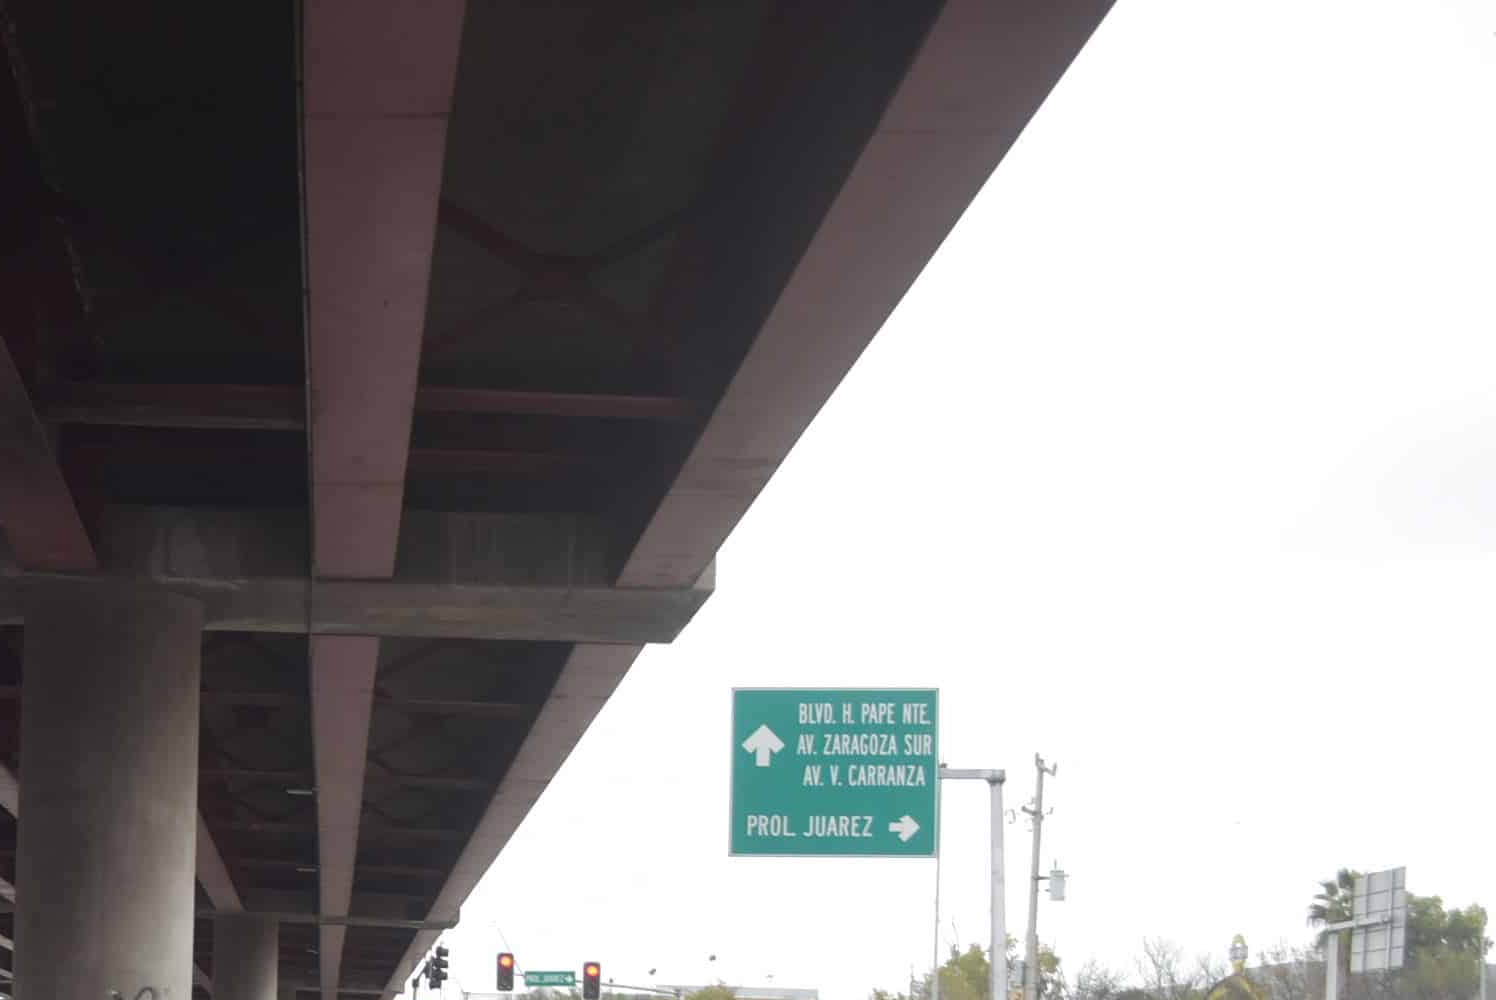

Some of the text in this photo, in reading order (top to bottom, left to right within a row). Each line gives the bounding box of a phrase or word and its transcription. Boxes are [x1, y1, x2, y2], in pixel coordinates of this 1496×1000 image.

[799, 703, 931, 724] BLVD. H. PAPE NTE.
[796, 734, 933, 756] AV. ZARAGOZA SUR
[802, 765, 926, 786] AV. V. CARRANZA
[803, 815, 873, 837] JUAREZ
